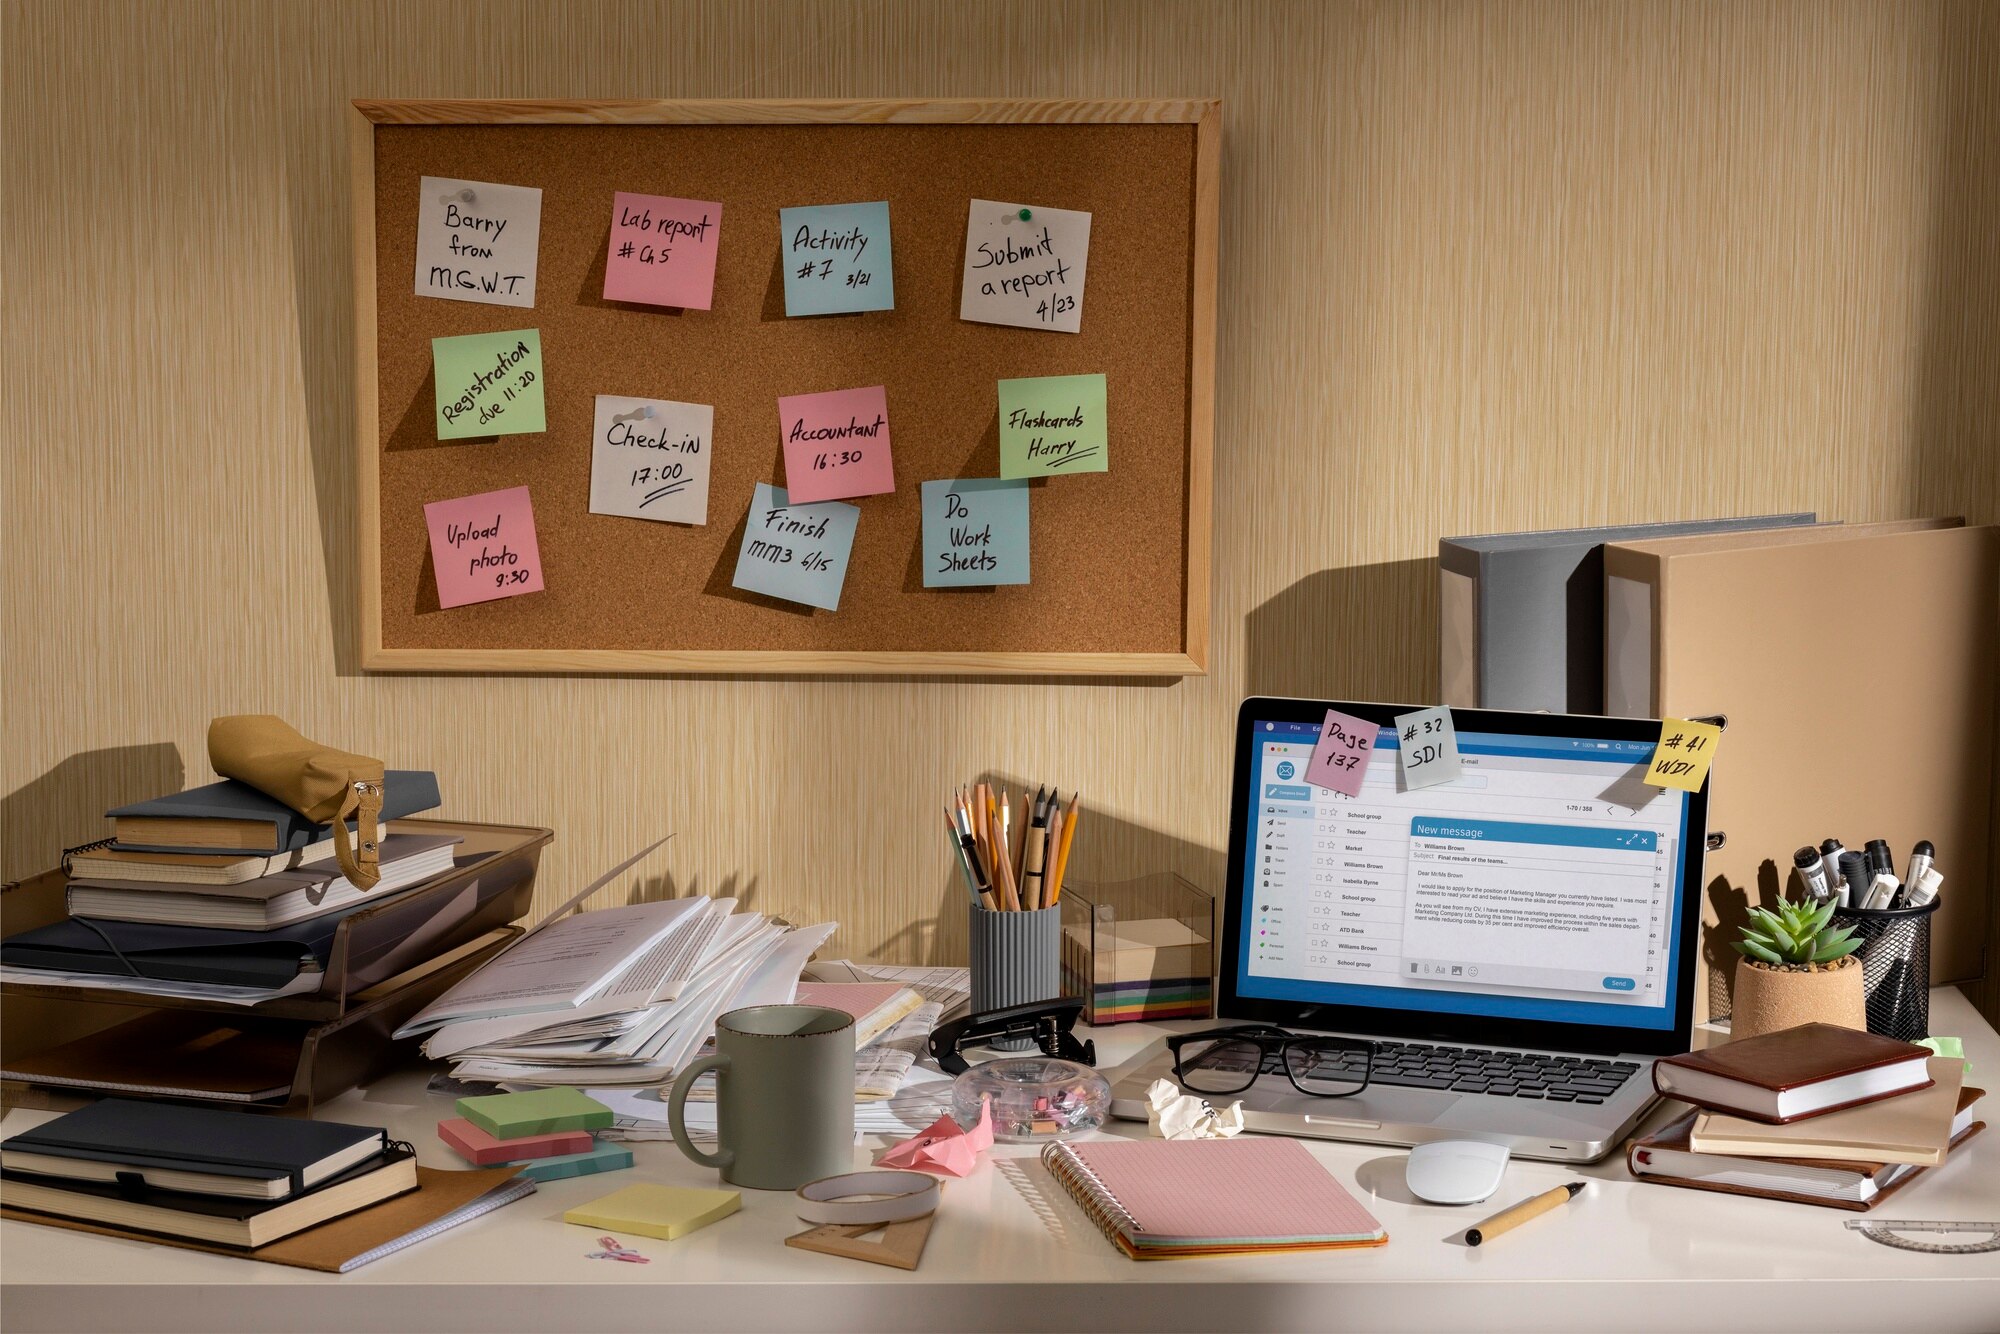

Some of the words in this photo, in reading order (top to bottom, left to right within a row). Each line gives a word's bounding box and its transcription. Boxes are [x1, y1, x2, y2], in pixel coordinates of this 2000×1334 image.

[445, 204, 507, 242] Barry
[621, 207, 651, 230] Lab
[657, 215, 712, 243] report
[449, 234, 492, 258] from
[793, 225, 868, 263] Activity
[972, 227, 1053, 268] Submit
[430, 266, 525, 296] M.G.W.T.
[846, 270, 871, 288] 3/21
[981, 282, 996, 296] a
[1002, 258, 1071, 297] report
[1036, 293, 1075, 322] 4/23
[479, 404, 505, 425] due
[503, 371, 535, 401] 11:20
[790, 414, 885, 443] Accountant
[1008, 406, 1083, 429] Flashcards
[814, 451, 862, 470] 16:30
[1028, 440, 1076, 459] Harry
[632, 463, 682, 486] 17:00
[945, 493, 968, 519] Do
[448, 514, 500, 548] Upload
[766, 508, 830, 539] Finish
[950, 525, 991, 548] Work
[470, 545, 518, 576] photo
[801, 551, 833, 571] 6/15
[938, 552, 997, 573] Sheets
[496, 569, 529, 587] 9:30
[1328, 722, 1368, 750] Page
[1327, 752, 1360, 771] 137
[1417, 825, 1438, 834] New
[1440, 827, 1483, 839] message
[1415, 908, 1439, 916] Marketing
